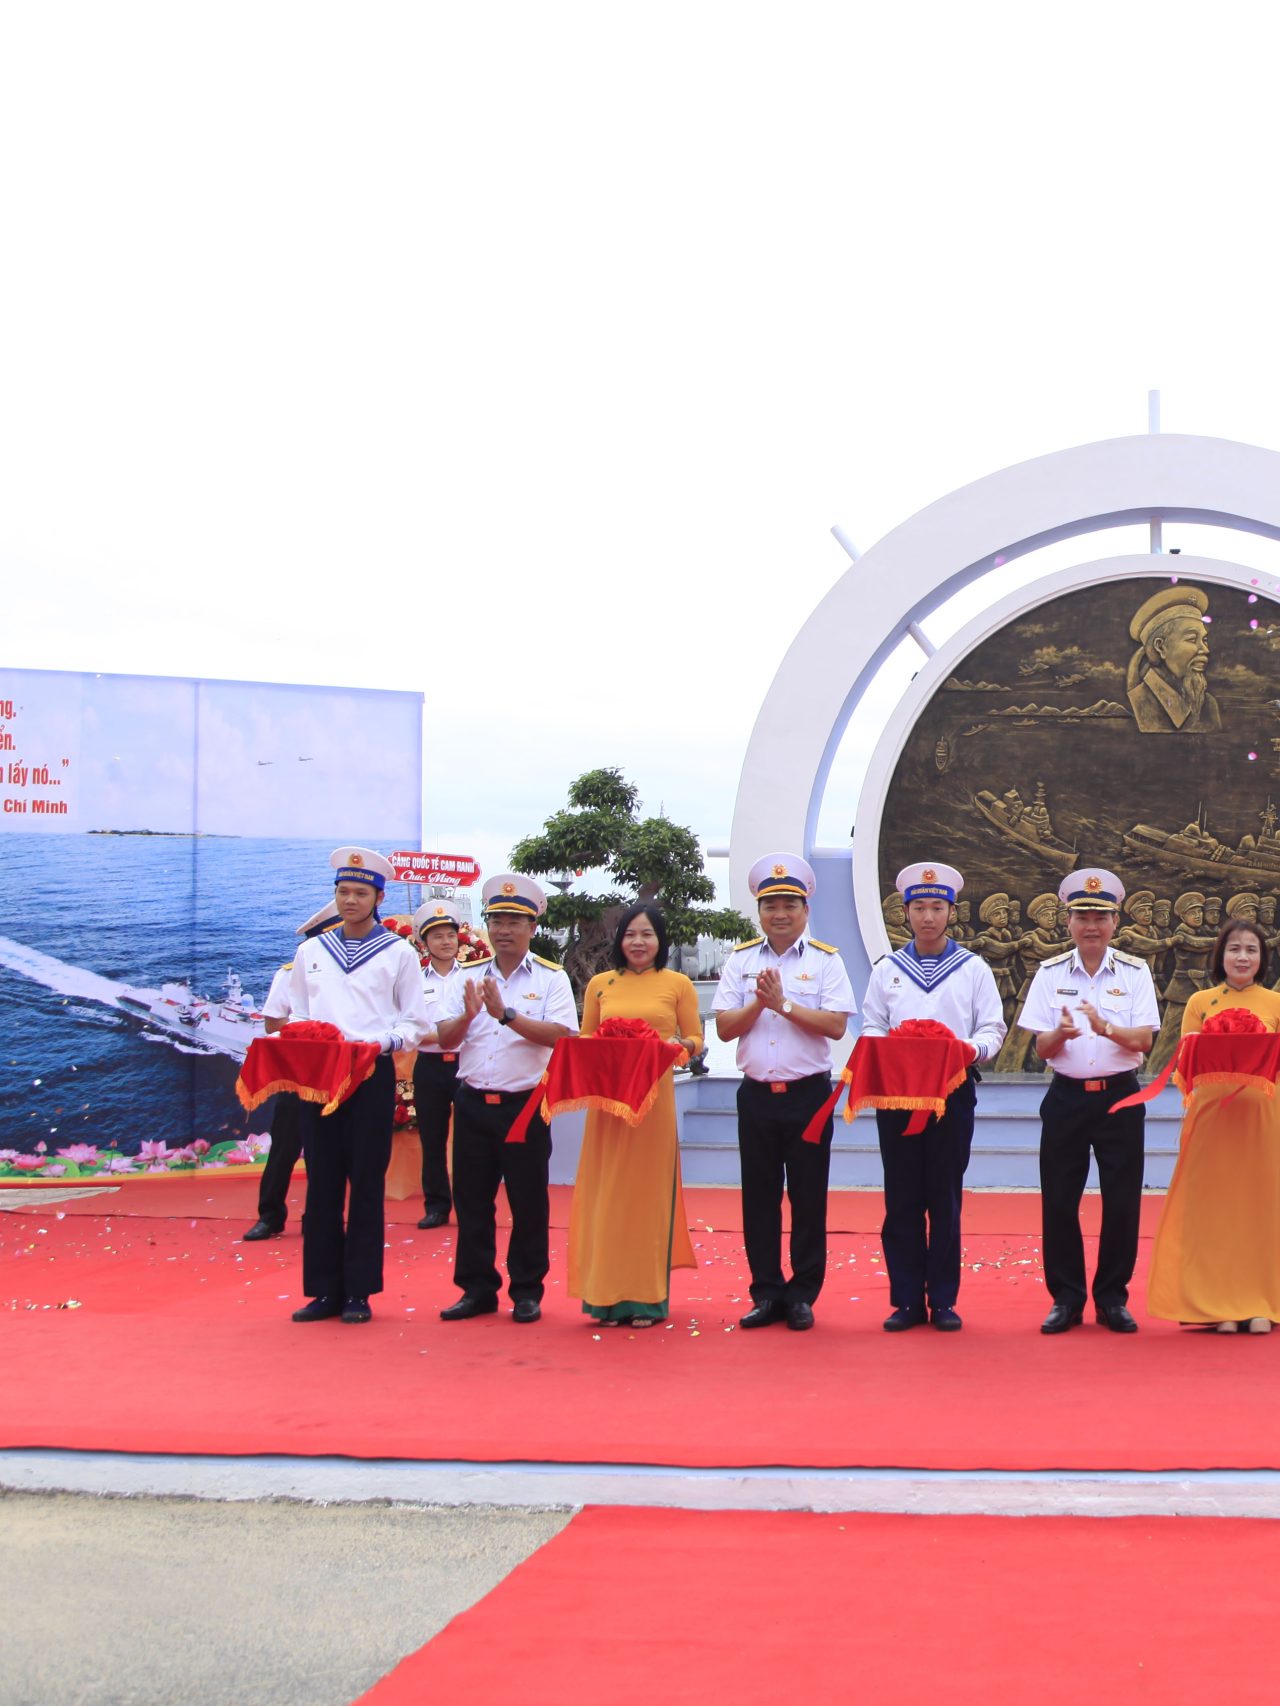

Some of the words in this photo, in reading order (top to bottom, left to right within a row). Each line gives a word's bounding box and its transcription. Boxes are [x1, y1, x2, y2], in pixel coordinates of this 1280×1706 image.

[8, 759, 28, 787] lấy
[3, 798, 27, 813] Chí
[32, 799, 67, 814] Minh
[412, 854, 430, 870] QUỐC
[431, 856, 439, 871] TẾ
[440, 860, 456, 872] CAM
[456, 861, 475, 873] RANH
